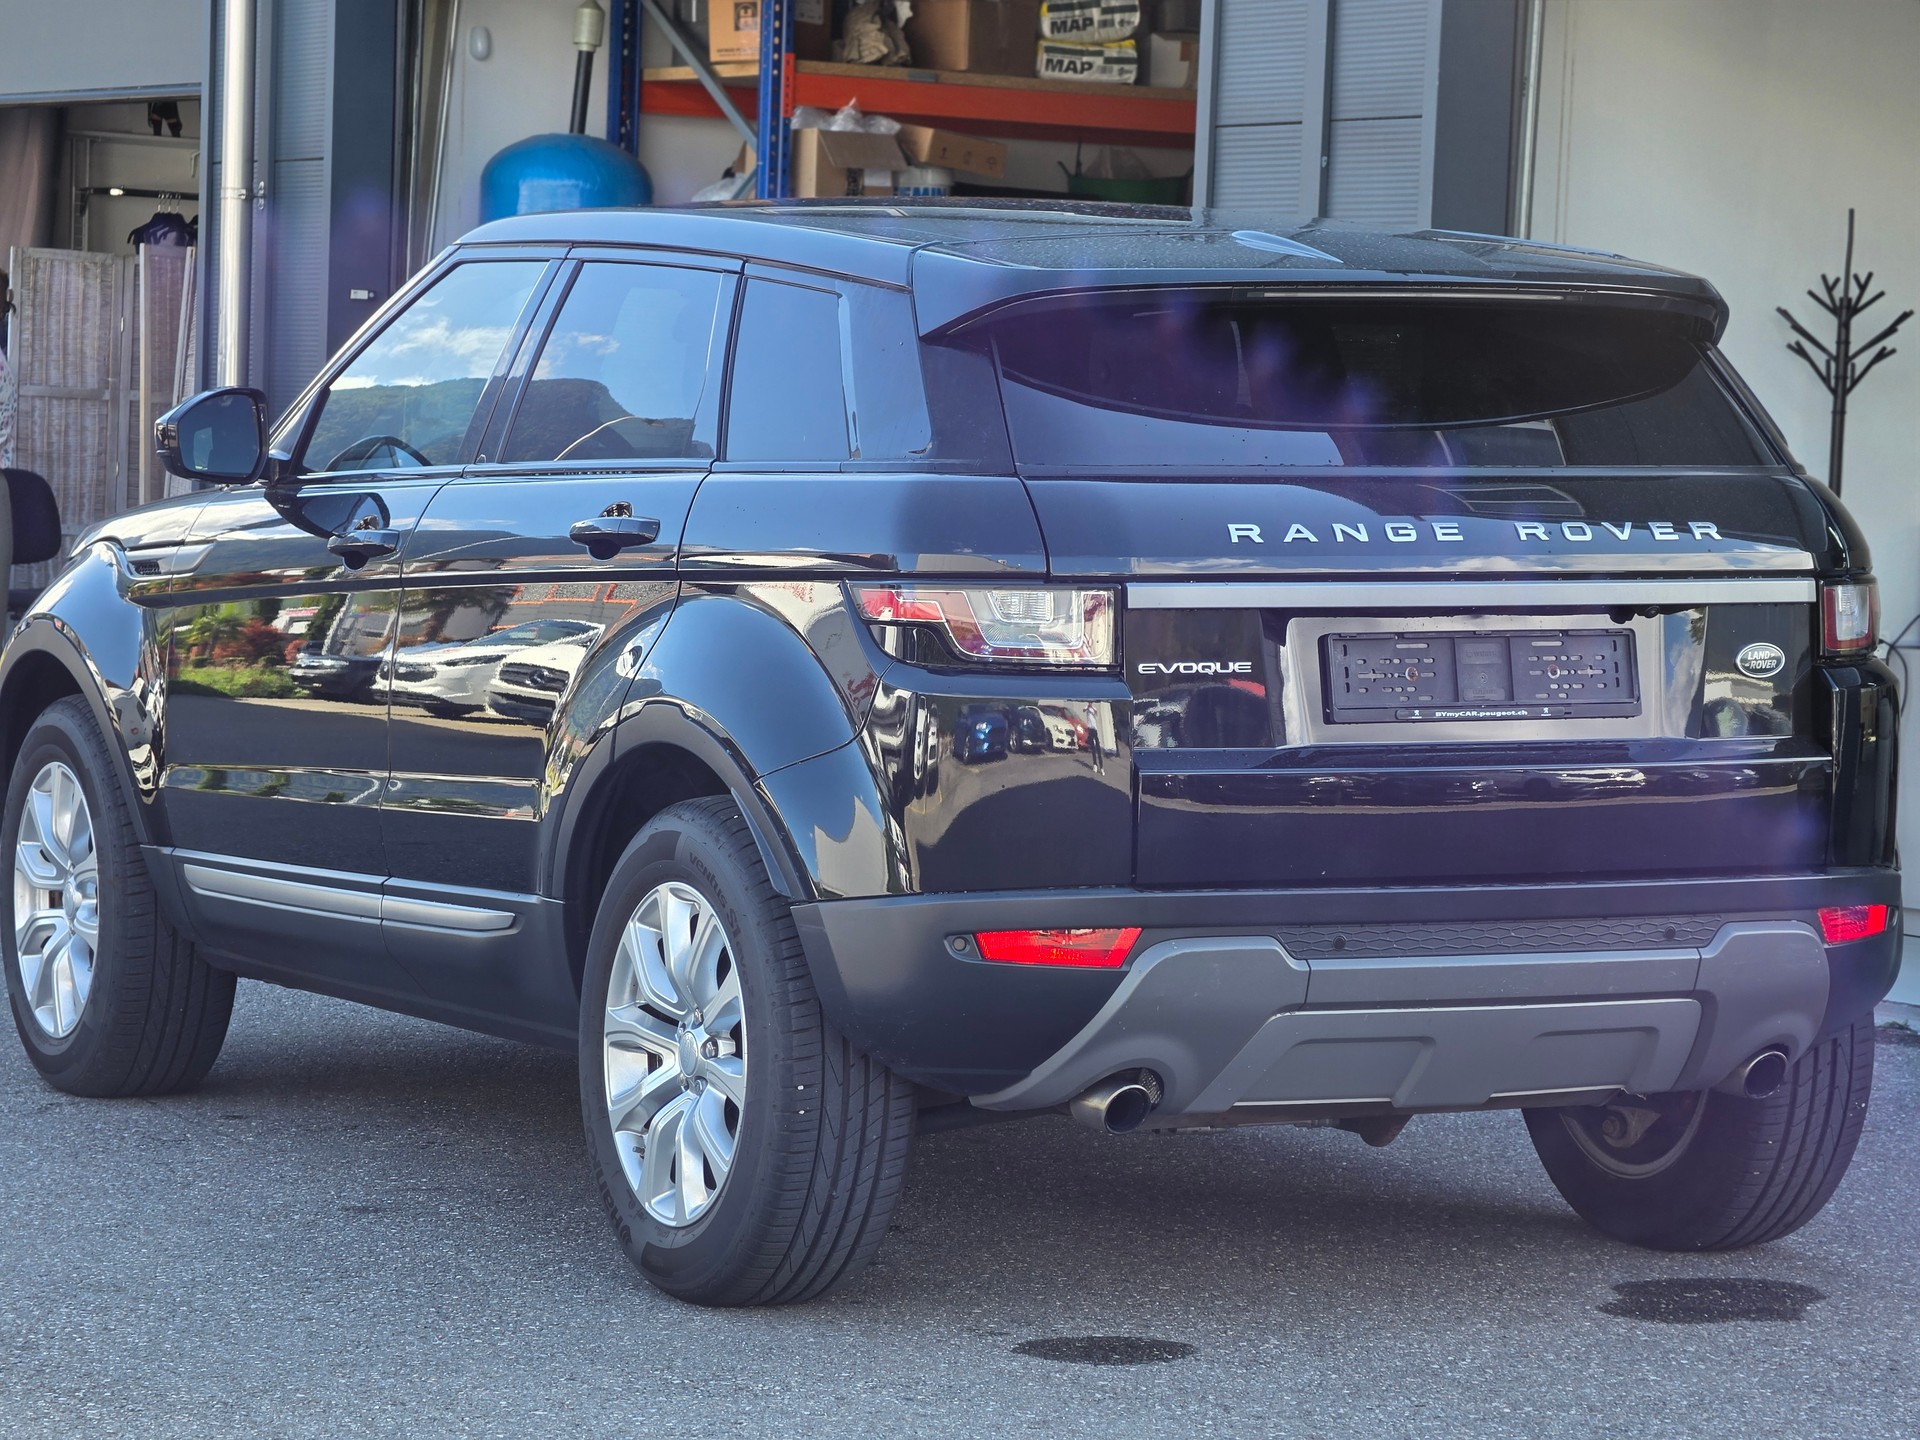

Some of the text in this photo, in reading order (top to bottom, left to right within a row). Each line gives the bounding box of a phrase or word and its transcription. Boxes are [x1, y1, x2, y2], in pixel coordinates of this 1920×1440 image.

[1050, 17, 1094, 35] MAP
[1044, 58, 1093, 75] MAP
[1228, 520, 1724, 544] RANGE ROVER
[1747, 650, 1770, 660] LAND
[1138, 661, 1252, 675] EVOQUE
[1750, 660, 1777, 669] ROVER
[1435, 710, 1528, 718] BYmyCAR.peugeot.ch
